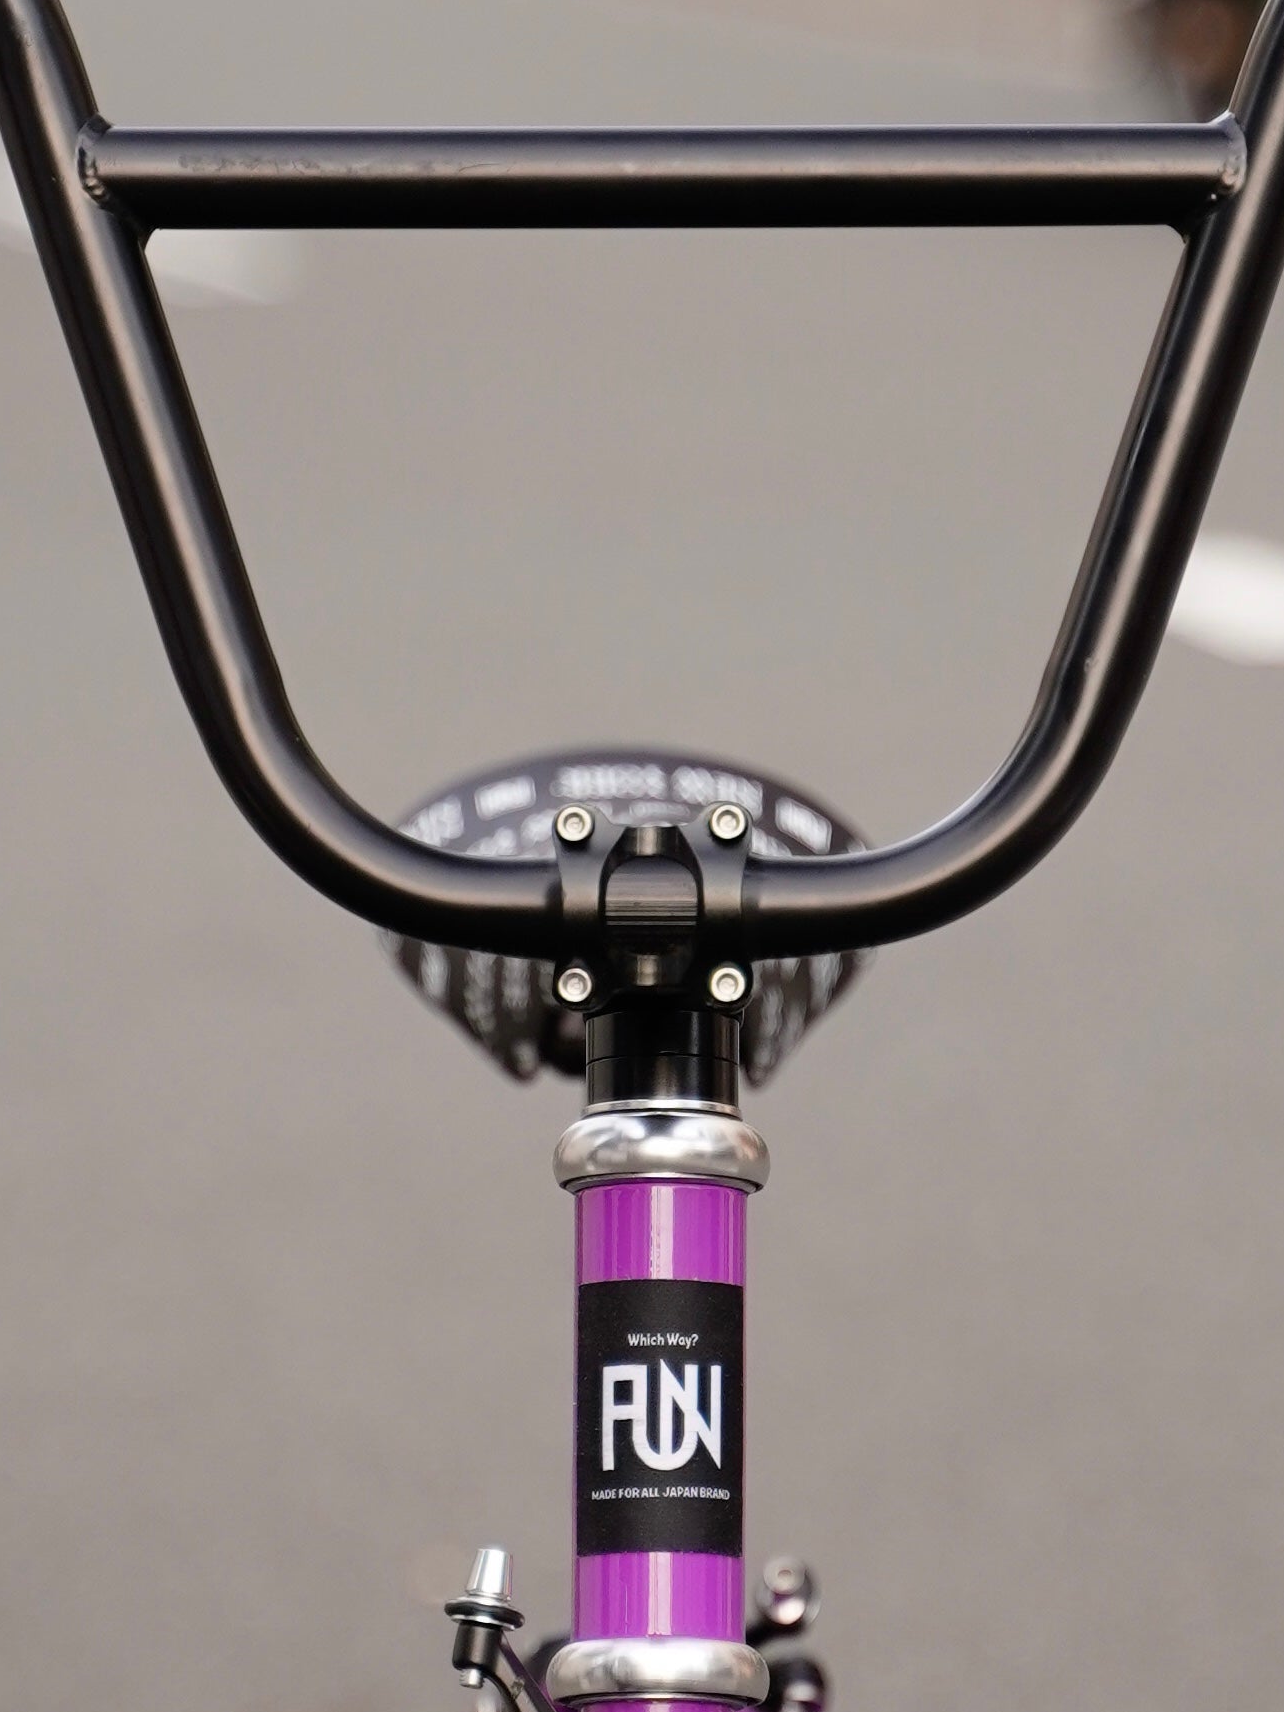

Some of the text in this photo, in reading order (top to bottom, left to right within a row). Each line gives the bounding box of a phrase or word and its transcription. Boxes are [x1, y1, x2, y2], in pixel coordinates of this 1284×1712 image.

[627, 1333, 699, 1349] Which Way?
[602, 1359, 722, 1472] FUN
[591, 1486, 731, 1501] MADE FOR ALL JAPAN BRAND
